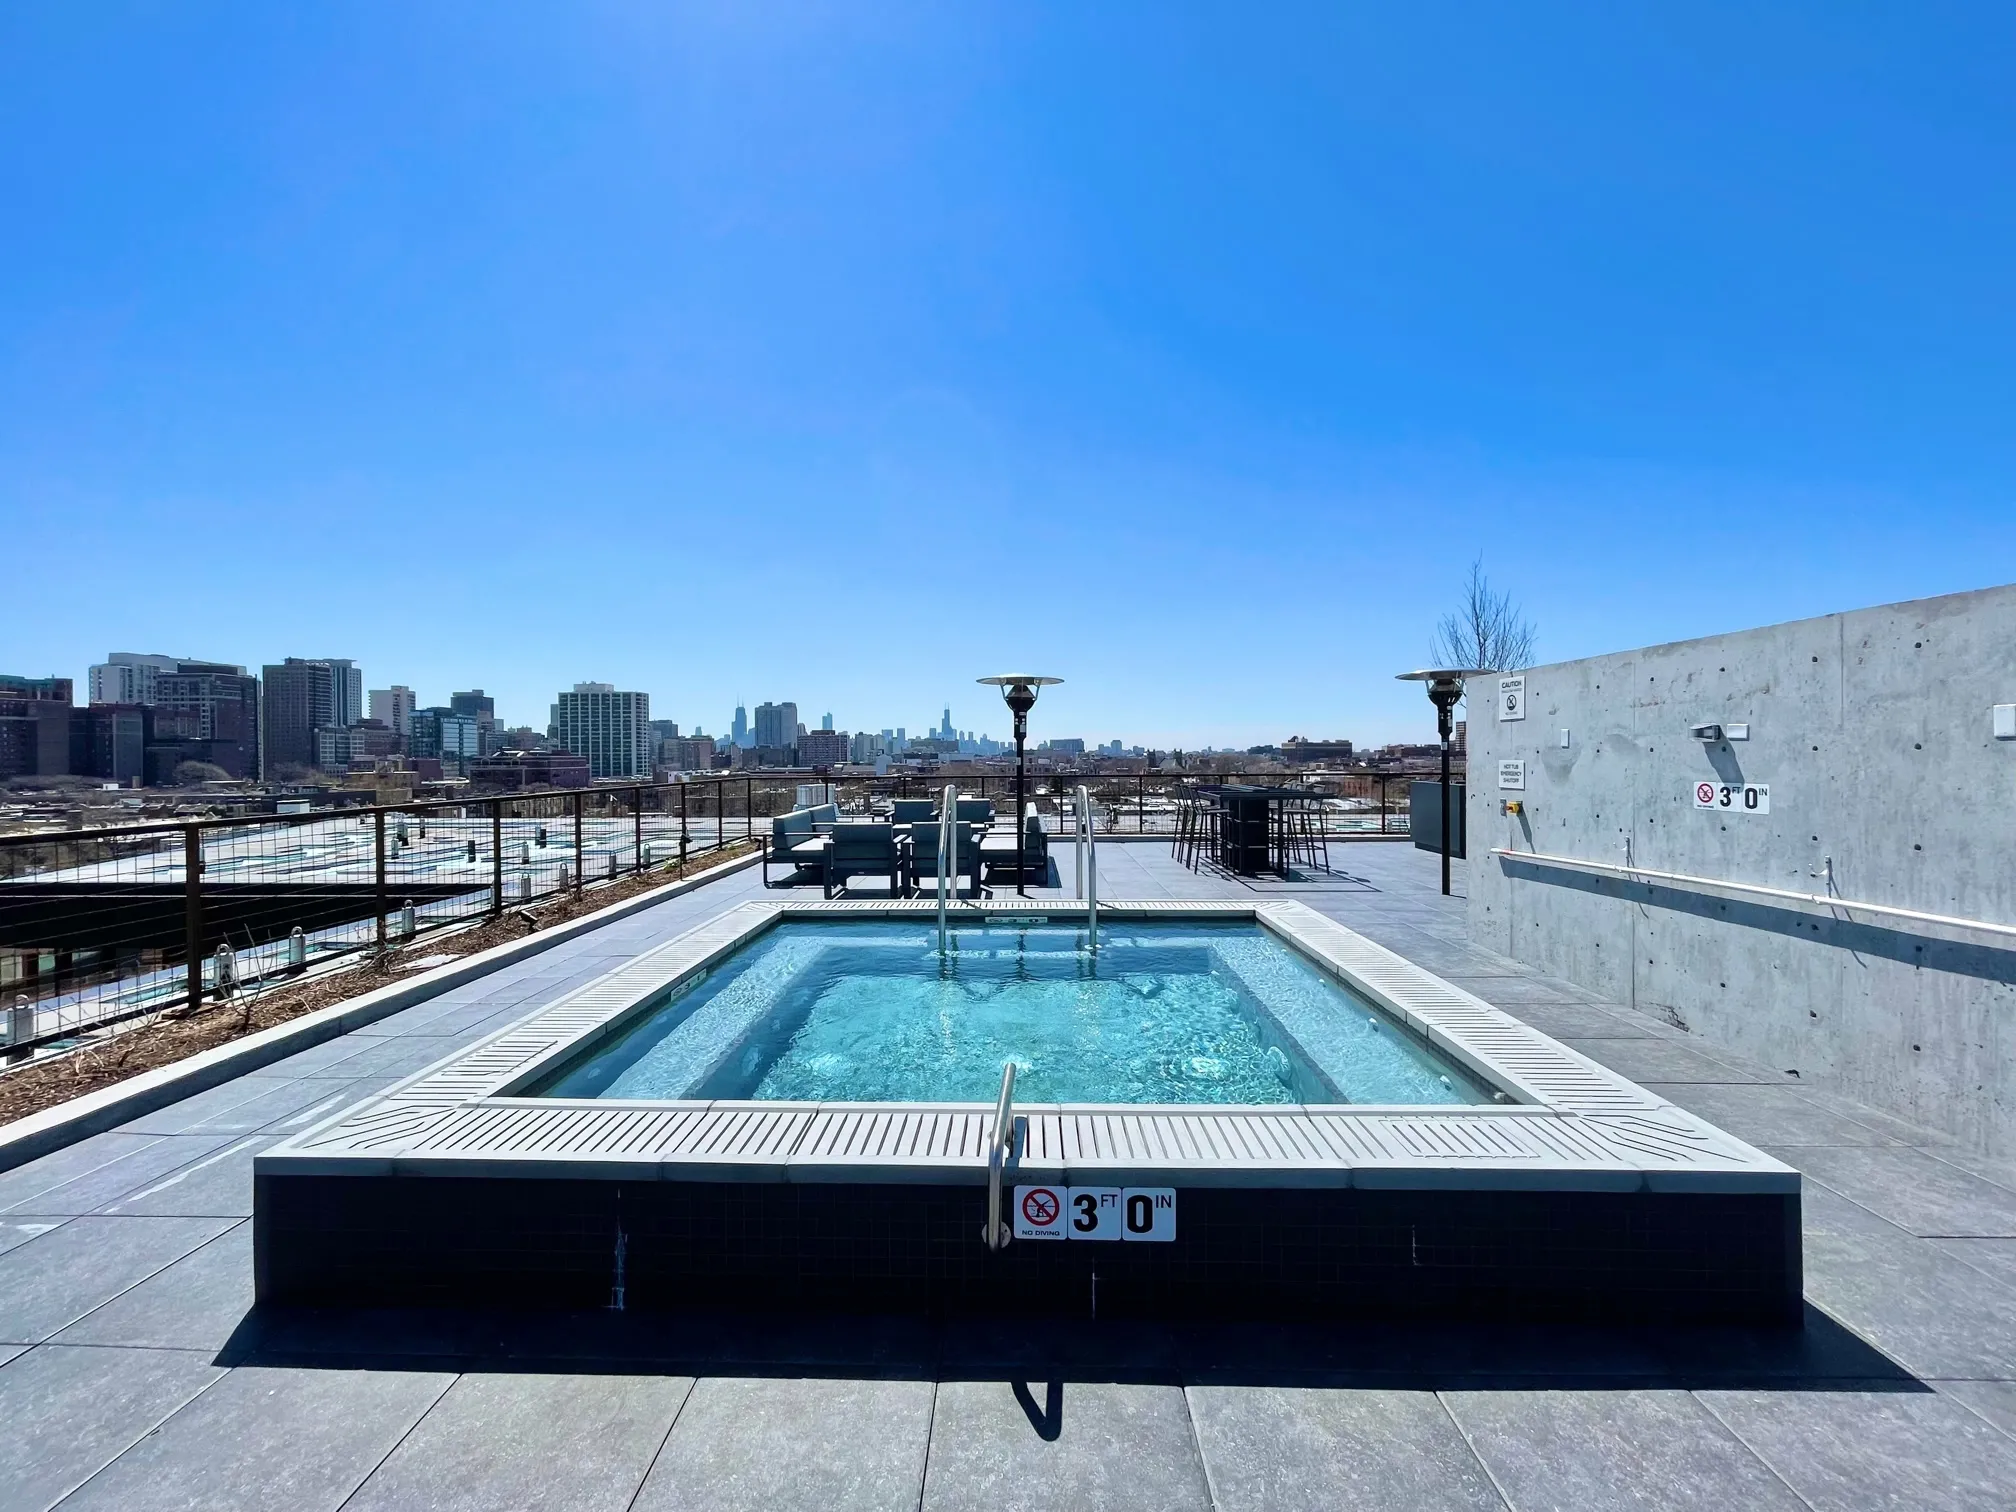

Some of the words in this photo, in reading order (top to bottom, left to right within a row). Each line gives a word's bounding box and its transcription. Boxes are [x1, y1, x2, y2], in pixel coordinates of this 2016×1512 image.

[1502, 680, 1522, 688] CAUTION
[1720, 786, 1731, 807] 3
[1732, 786, 1741, 794] FT
[1745, 788, 1758, 809] 0
[1759, 788, 1768, 796] IN
[1073, 1194, 1098, 1232] 3
[1101, 1194, 1118, 1208] FT
[1127, 1195, 1153, 1233] 0
[1156, 1195, 1172, 1208] IN
